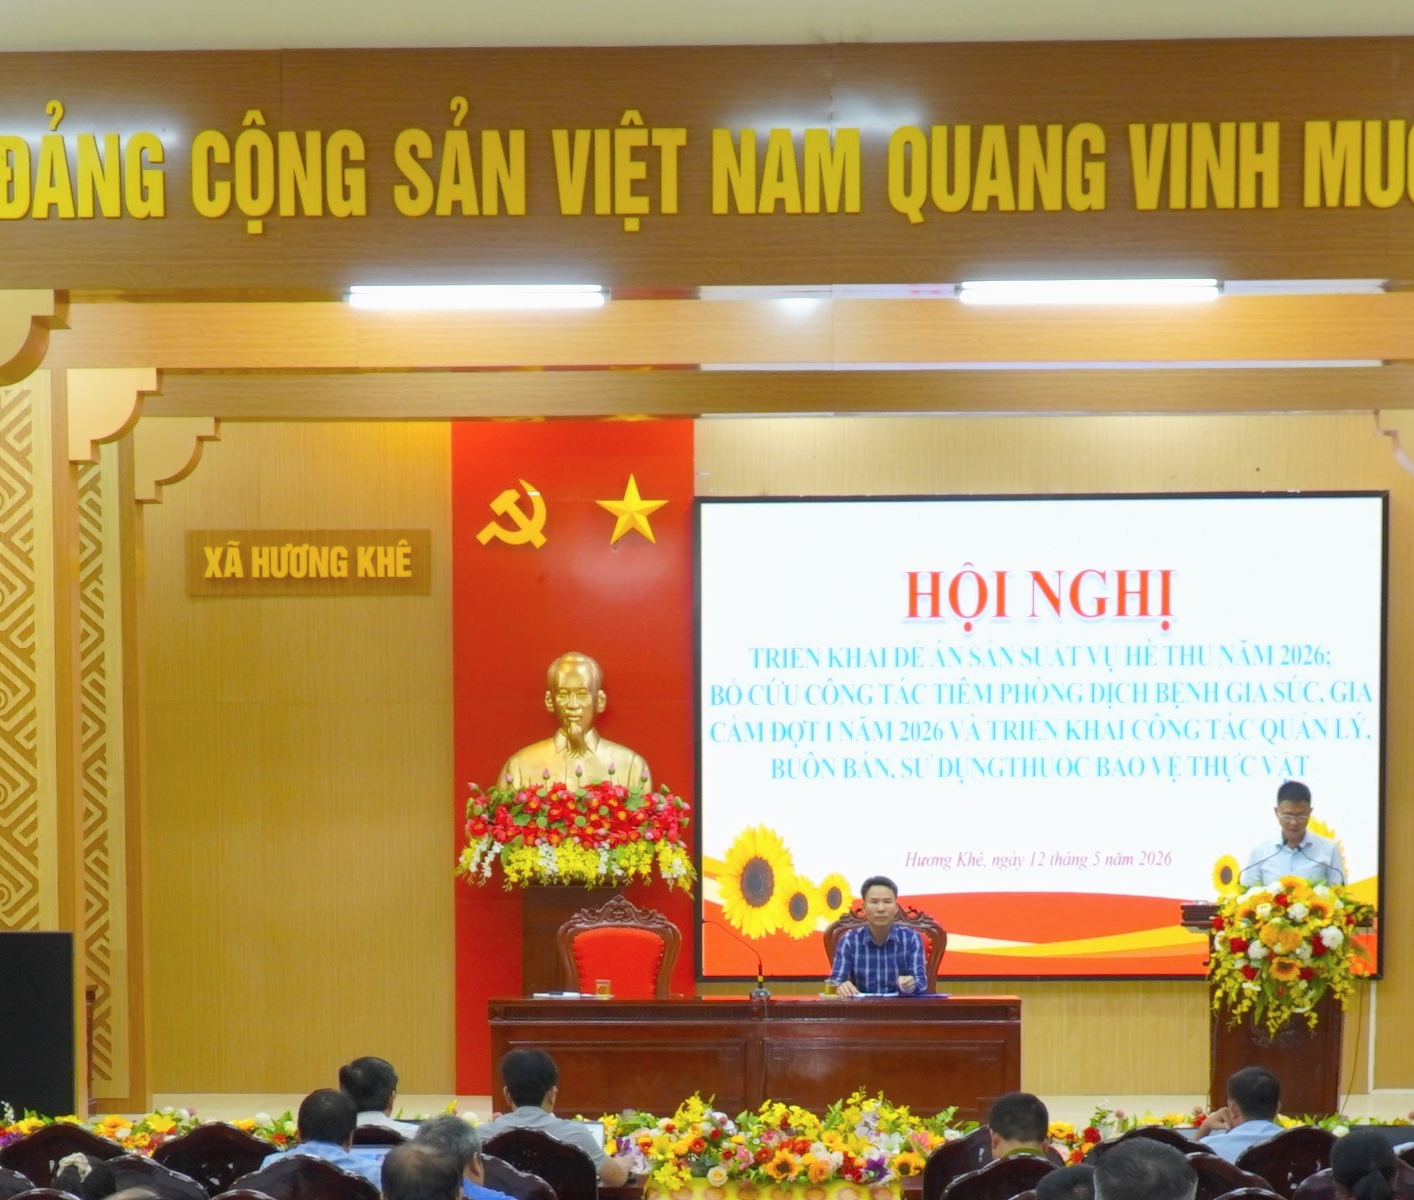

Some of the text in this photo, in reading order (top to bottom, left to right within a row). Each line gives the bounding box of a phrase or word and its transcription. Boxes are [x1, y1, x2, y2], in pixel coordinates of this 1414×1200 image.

[191, 109, 367, 234] CỘNG
[393, 96, 526, 216] SẢN
[552, 109, 687, 231] VIỆT
[712, 128, 861, 214] NAM
[887, 122, 1105, 224] QUANG
[1128, 121, 1279, 209] VINH
[203, 539, 412, 579] XÃ HƯƠNG KHÊ
[904, 562, 1175, 633] HỘI NGHỊ
[826, 646, 888, 669] KHAI
[1086, 646, 1119, 672] VỤ
[1162, 645, 1213, 667] THU
[1219, 639, 1274, 667] NĂM
[1279, 644, 1332, 669] 2026;
[803, 677, 874, 706] CÔNG
[879, 677, 927, 705] TÁC
[932, 676, 993, 705] TIÊM
[999, 676, 1084, 705] PHÒNG
[1089, 682, 1149, 709] DỊCH
[1225, 681, 1270, 703] GIA
[1272, 674, 1325, 704] SÚC,
[1329, 680, 1374, 703] GIA
[769, 719, 820, 748] ĐỢT
[825, 721, 834, 742] I
[838, 714, 894, 743] NĂM
[899, 720, 945, 742] 2026
[948, 714, 982, 742] VÀ
[1064, 719, 1126, 741] KHAI
[1130, 712, 1202, 741] CÔNG
[1205, 712, 1255, 741] TÁC
[1334, 711, 1372, 741] LÝ,
[770, 751, 836, 779] BUÔN
[842, 751, 896, 780] BÁN,
[1187, 752, 1255, 783] THỰC
[905, 851, 953, 871] Hương
[991, 851, 1025, 871] ngày
[1030, 851, 1046, 867] 12
[1050, 850, 1089, 870] tháng
[1093, 850, 1101, 866] 5
[1105, 851, 1134, 867] năm
[1139, 850, 1173, 866] 2026
